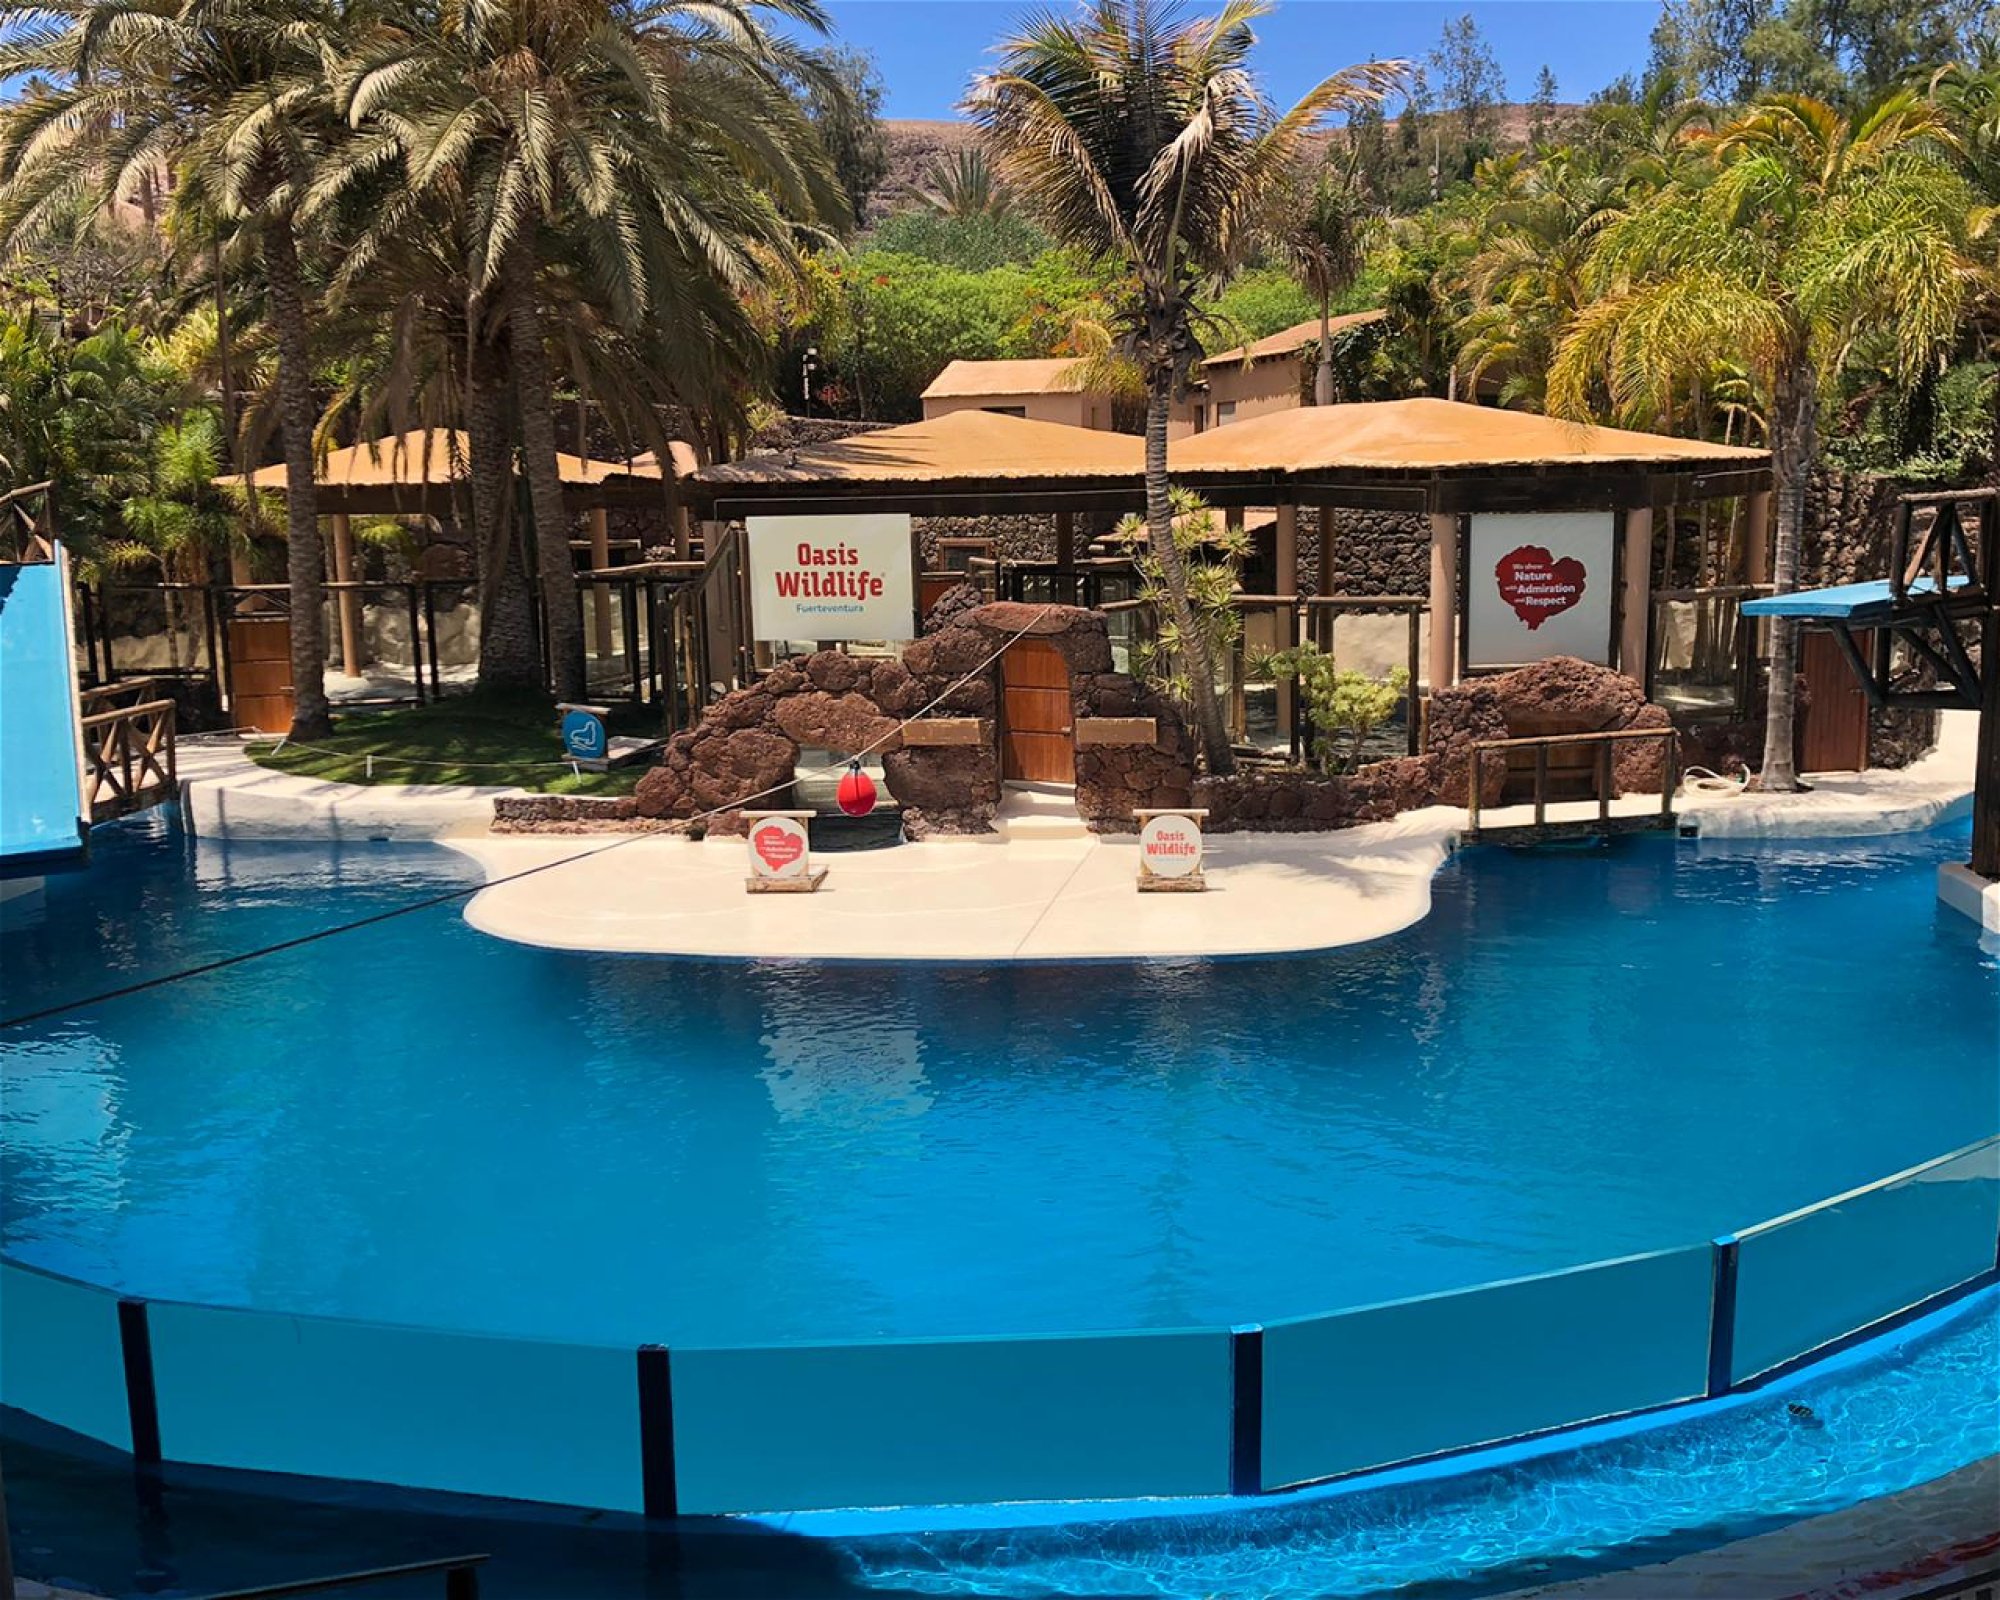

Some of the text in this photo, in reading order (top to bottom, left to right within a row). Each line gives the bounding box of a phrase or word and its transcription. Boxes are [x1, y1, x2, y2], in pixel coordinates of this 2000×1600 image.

[797, 542, 859, 566] Oasis
[1514, 571, 1553, 581] Nature
[775, 571, 884, 600] Wildlife
[1517, 583, 1576, 594] Admiration
[1525, 596, 1566, 607] Respect
[796, 604, 864, 613] Fuerteventura
[1156, 830, 1185, 841] Oasis
[1146, 843, 1196, 856] Wildlife
